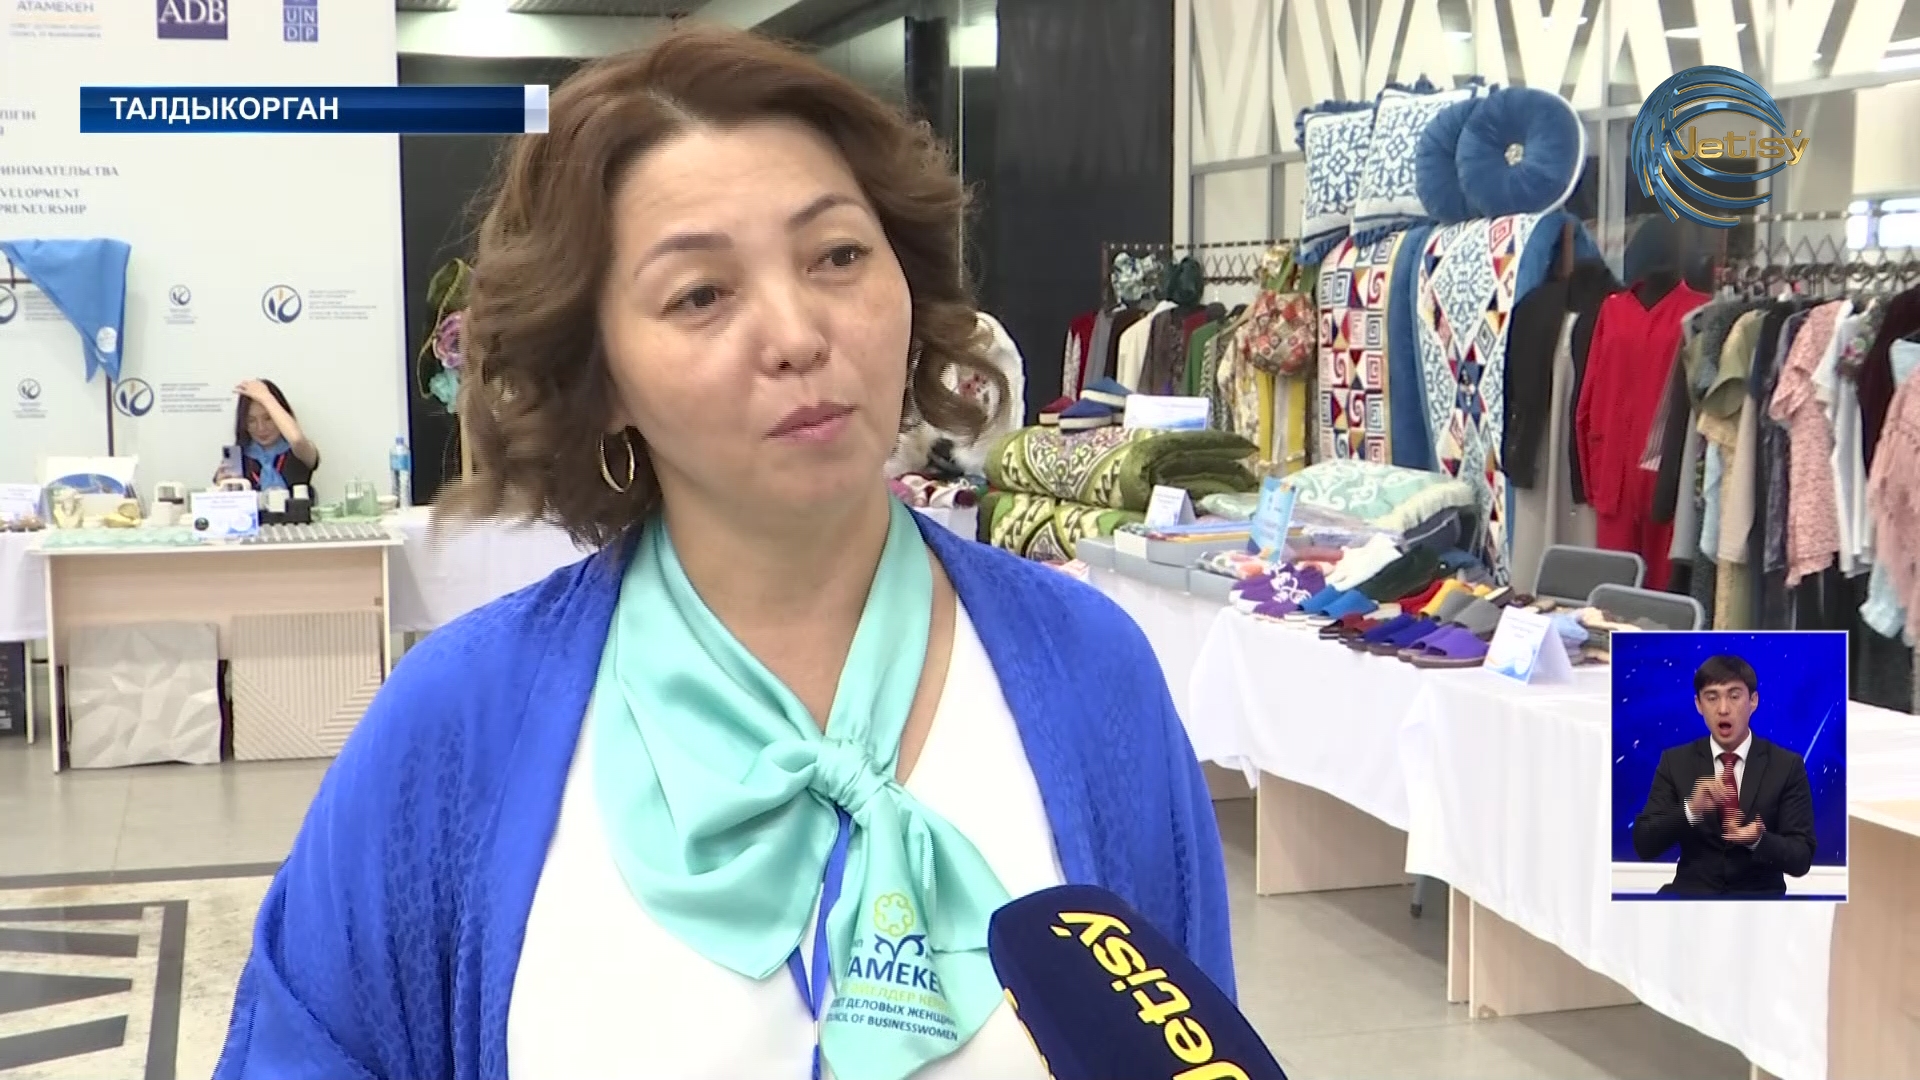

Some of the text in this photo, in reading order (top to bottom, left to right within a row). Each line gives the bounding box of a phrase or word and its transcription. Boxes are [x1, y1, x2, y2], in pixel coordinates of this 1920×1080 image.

[158, 0, 226, 24] ADB
[847, 955, 941, 994] АМЕКЕ
[846, 998, 905, 1016] ДЕЛОВЫХ
[850, 1013, 866, 1024] OF
[867, 1016, 958, 1041] BUSINESSWOMEN
